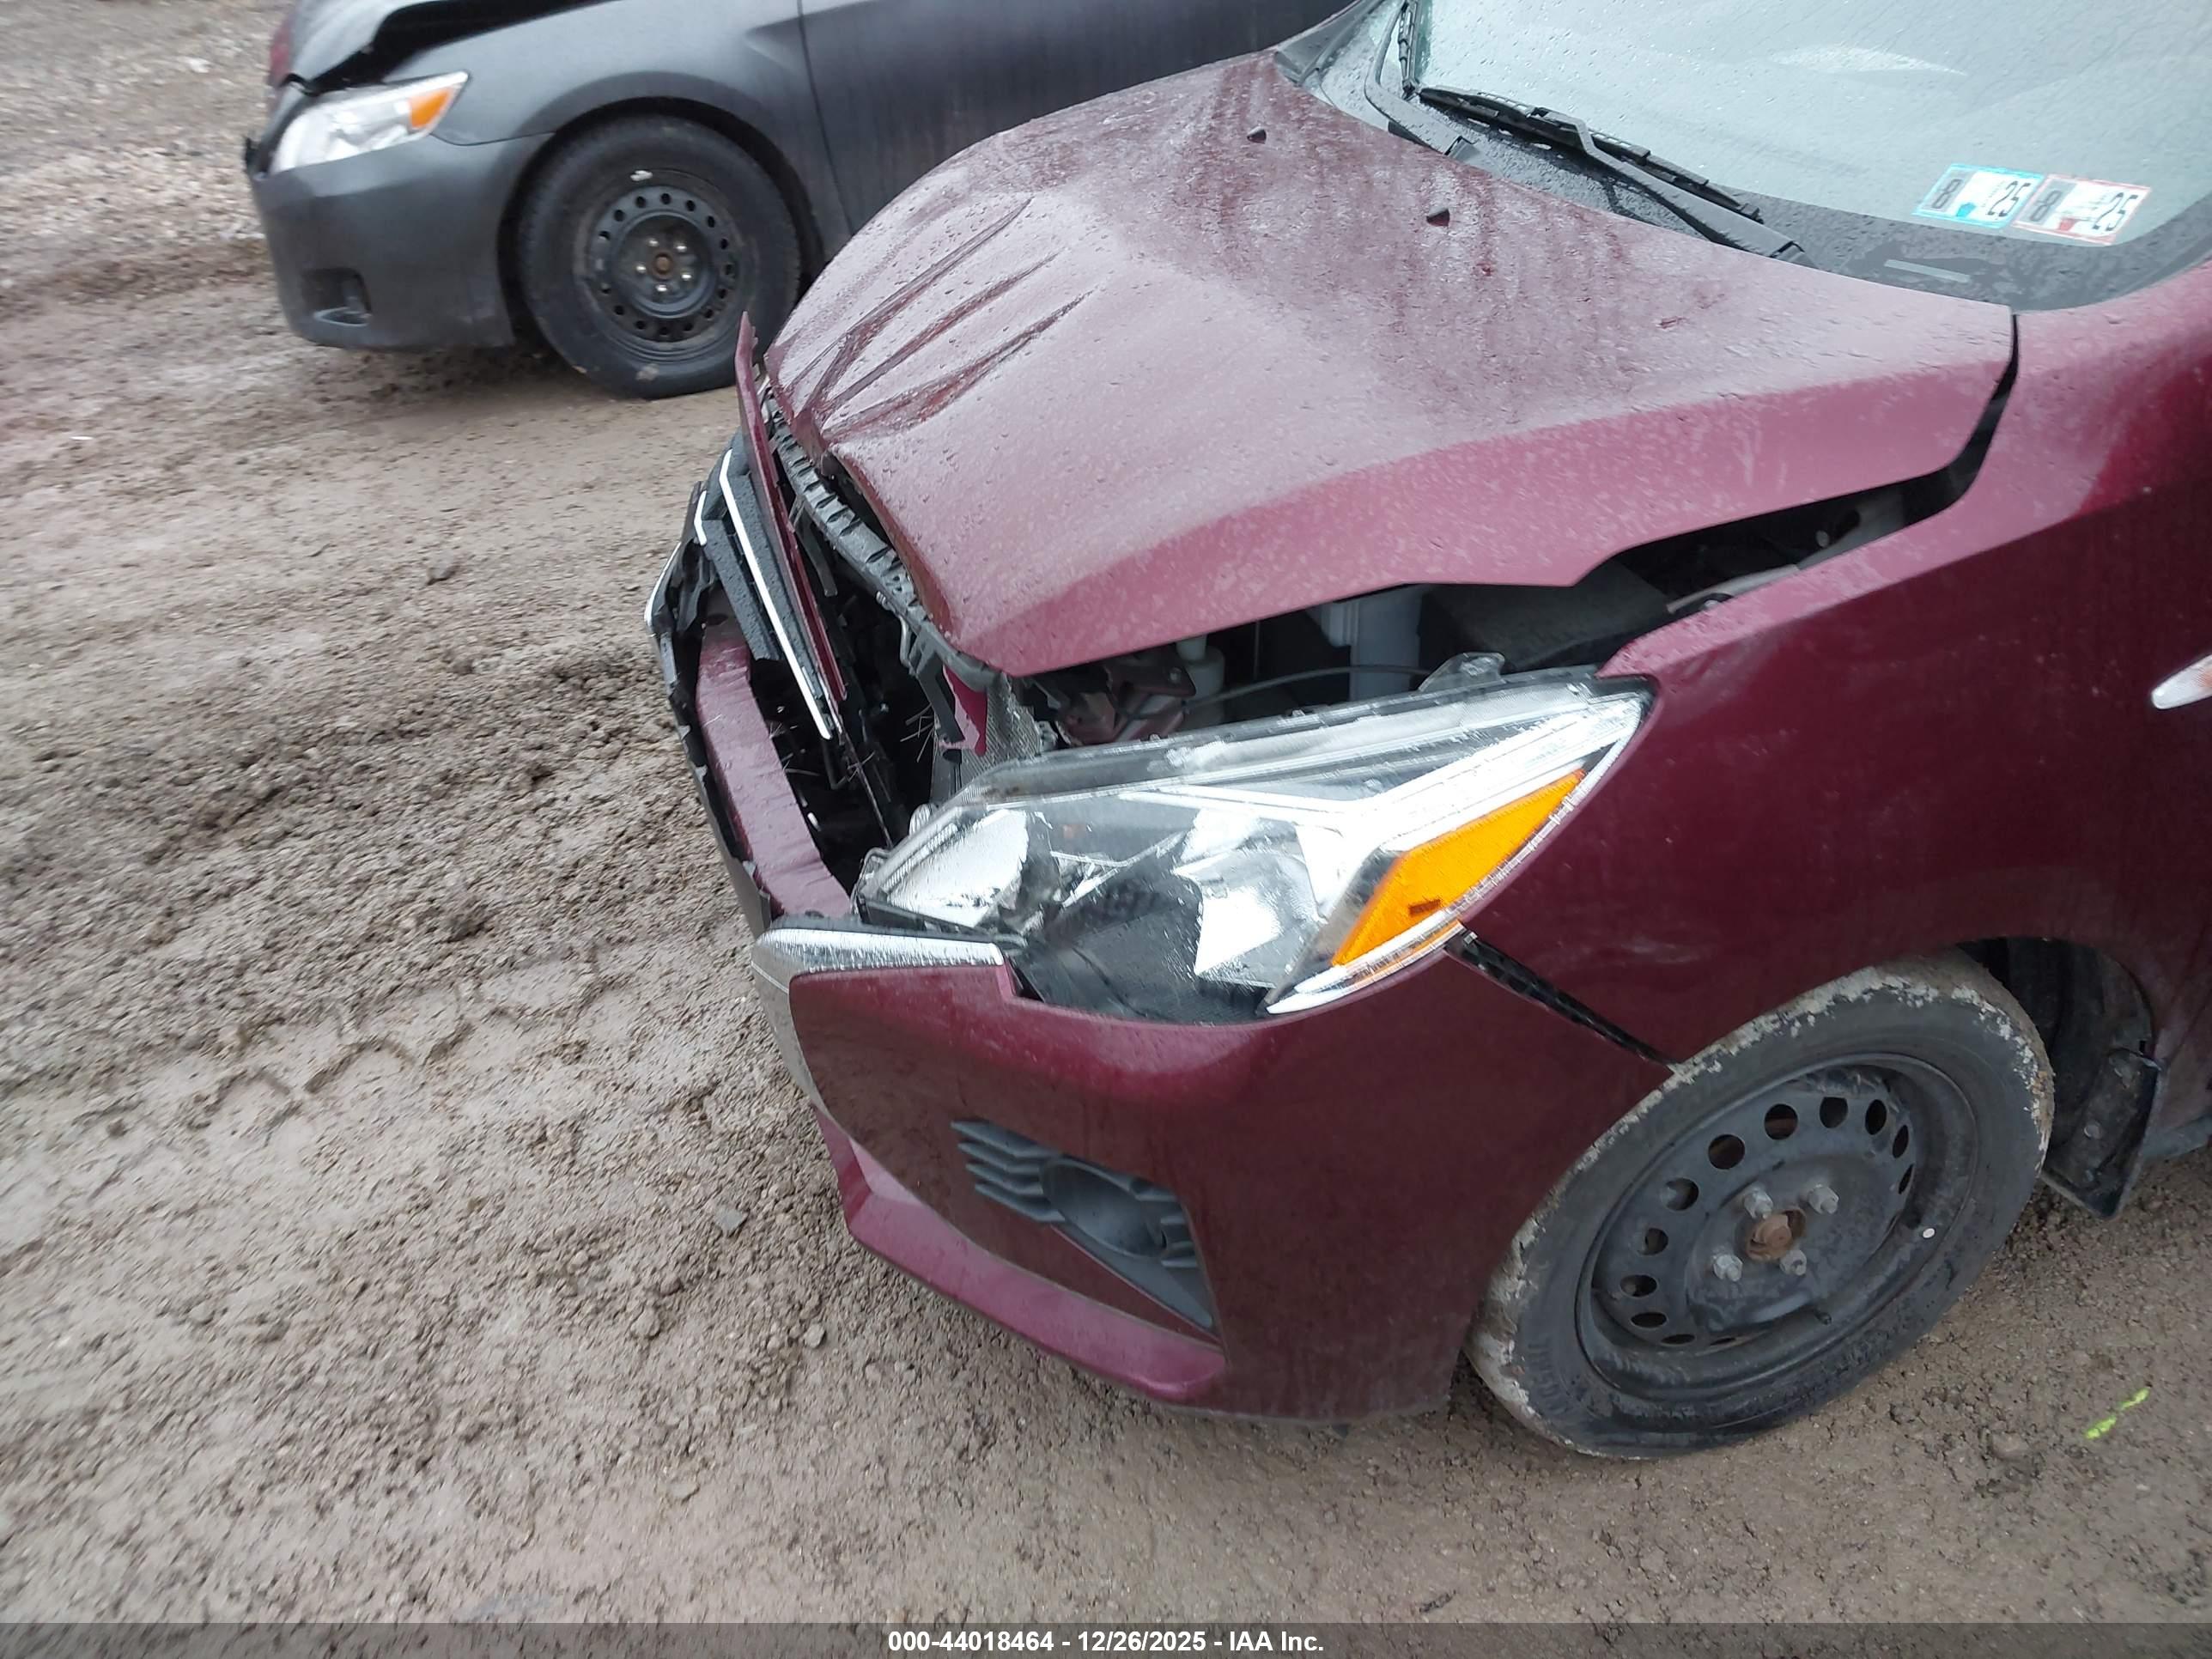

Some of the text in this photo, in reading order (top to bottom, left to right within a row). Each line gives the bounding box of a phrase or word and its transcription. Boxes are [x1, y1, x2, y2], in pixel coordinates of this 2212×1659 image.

[1931, 178, 1964, 210] 8
[1985, 180, 2032, 217] 25
[2029, 190, 2062, 222] 8
[2091, 191, 2139, 232] 25
